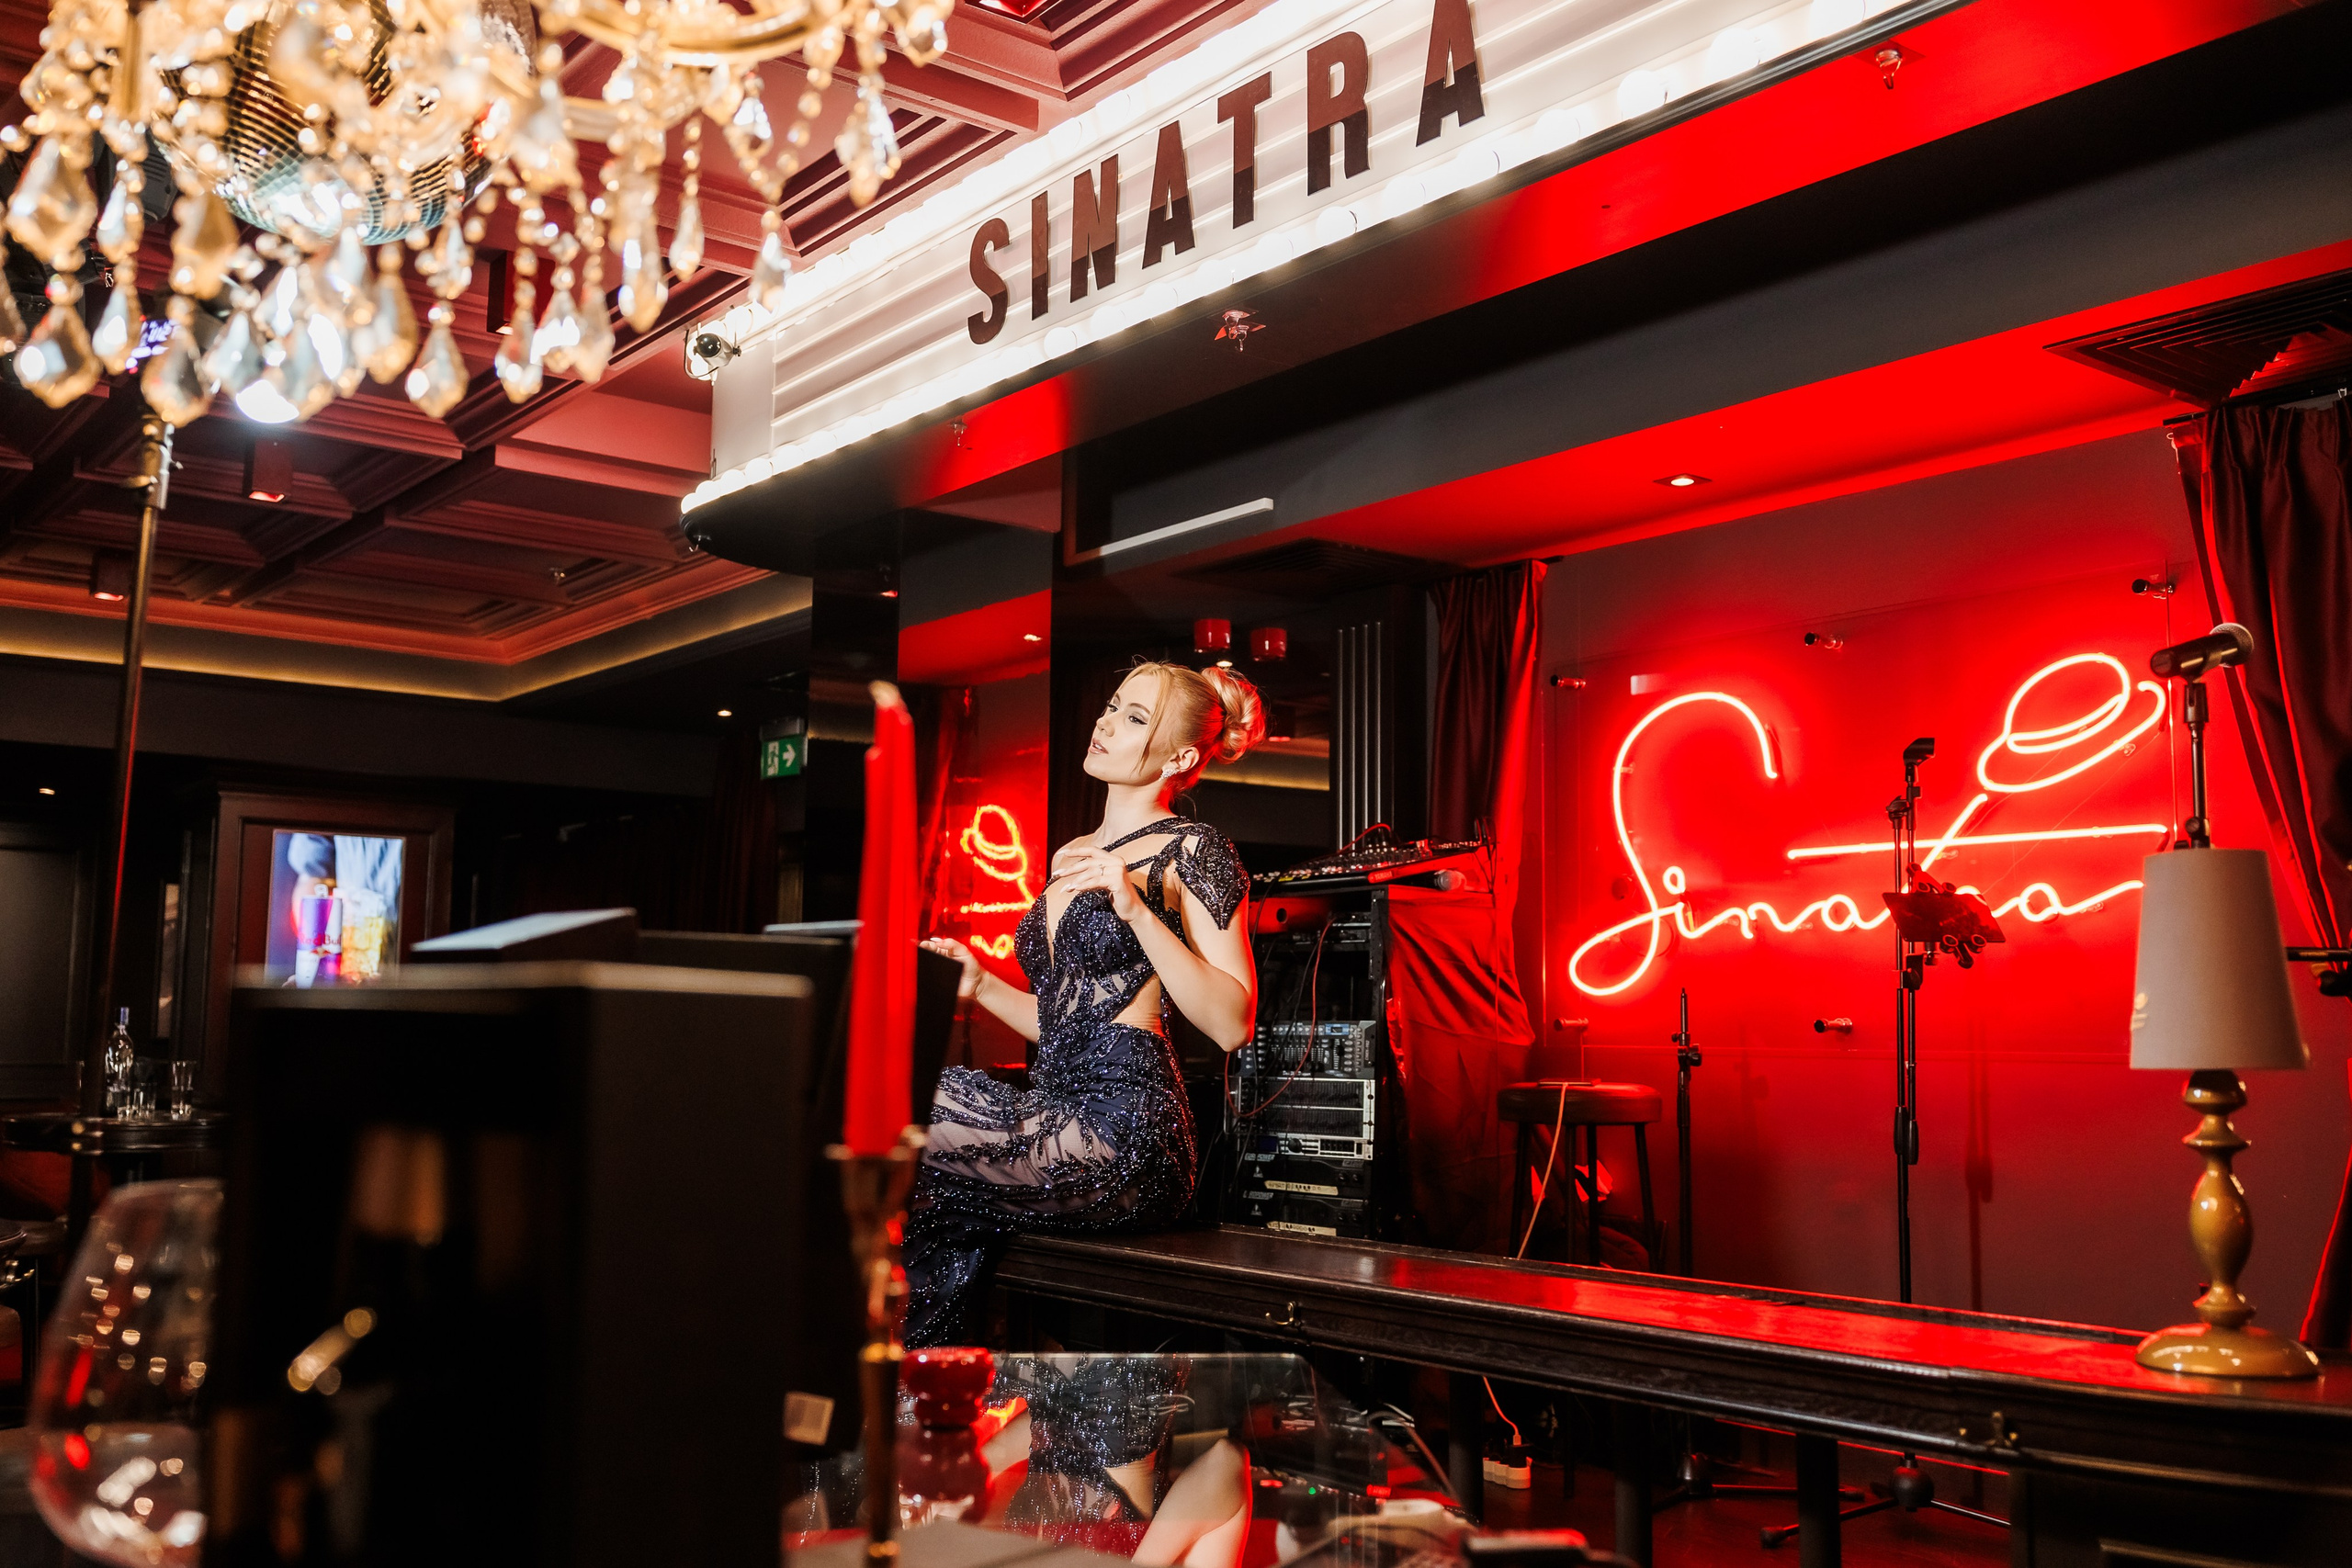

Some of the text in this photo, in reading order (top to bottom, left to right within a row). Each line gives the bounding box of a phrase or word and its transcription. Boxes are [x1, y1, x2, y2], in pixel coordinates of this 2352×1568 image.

[967, 0, 1485, 345] SINATRA
[299, 931, 322, 946] Red
[1569, 691, 2167, 996] Sinata
